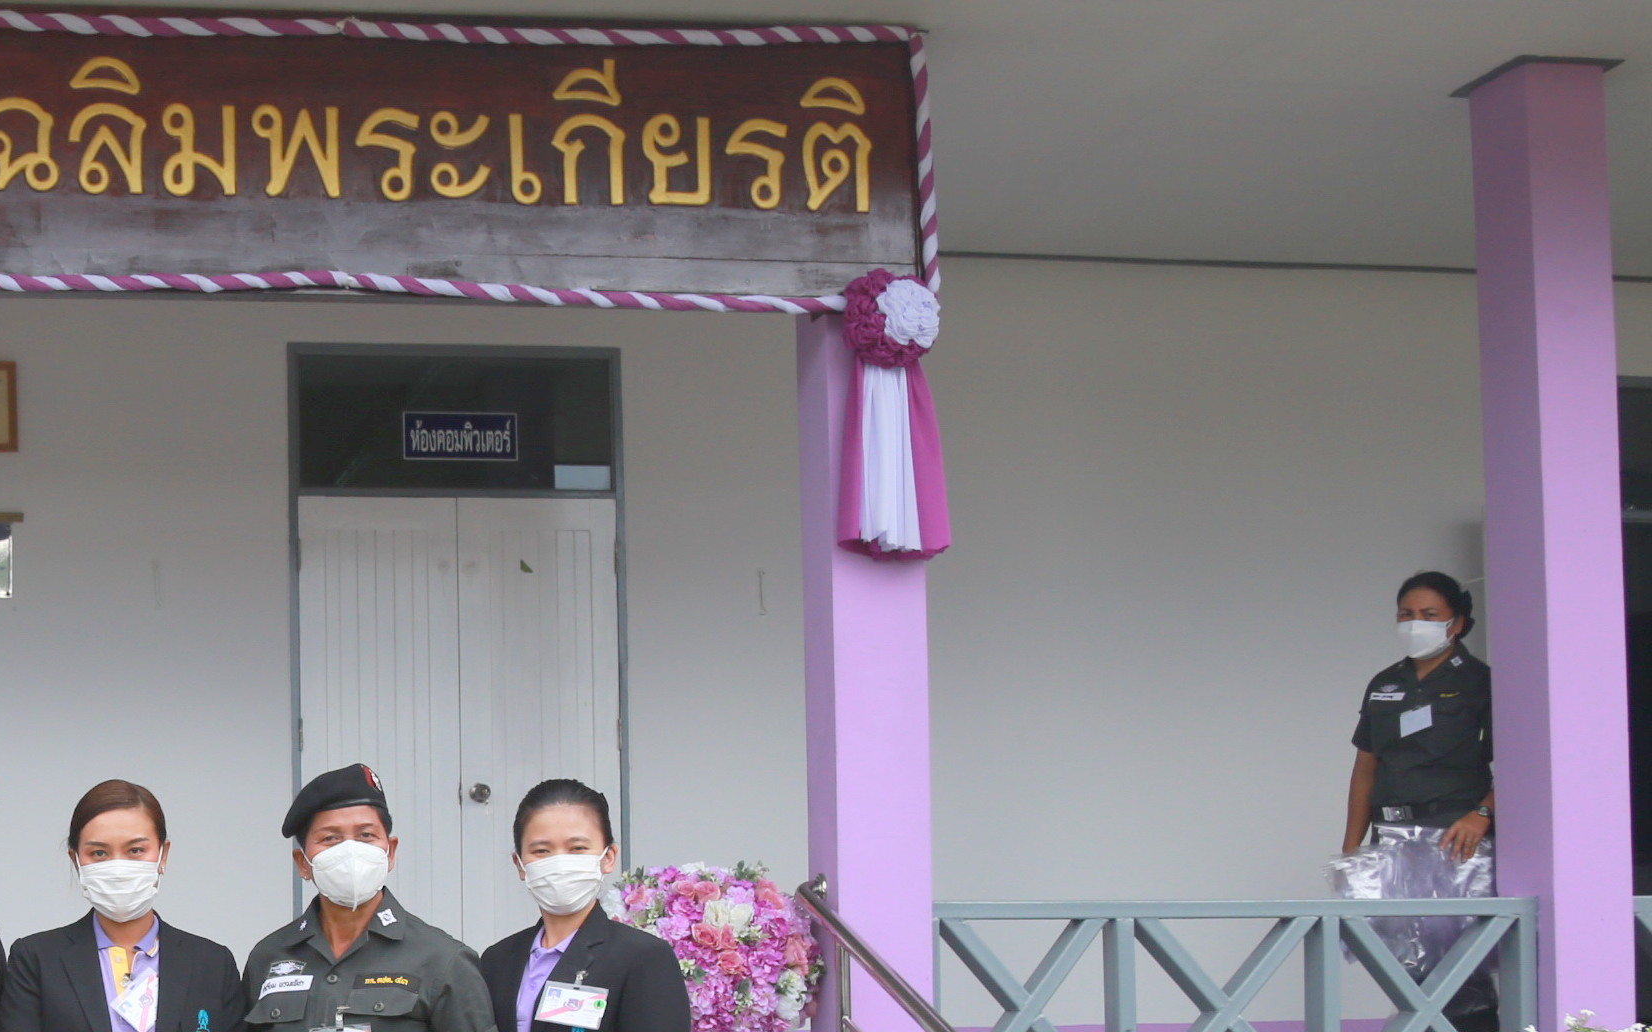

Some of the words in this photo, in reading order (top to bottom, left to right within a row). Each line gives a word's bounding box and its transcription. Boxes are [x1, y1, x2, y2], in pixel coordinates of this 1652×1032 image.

[410, 419, 512, 454] ห้องคอมพิวเตอร์
